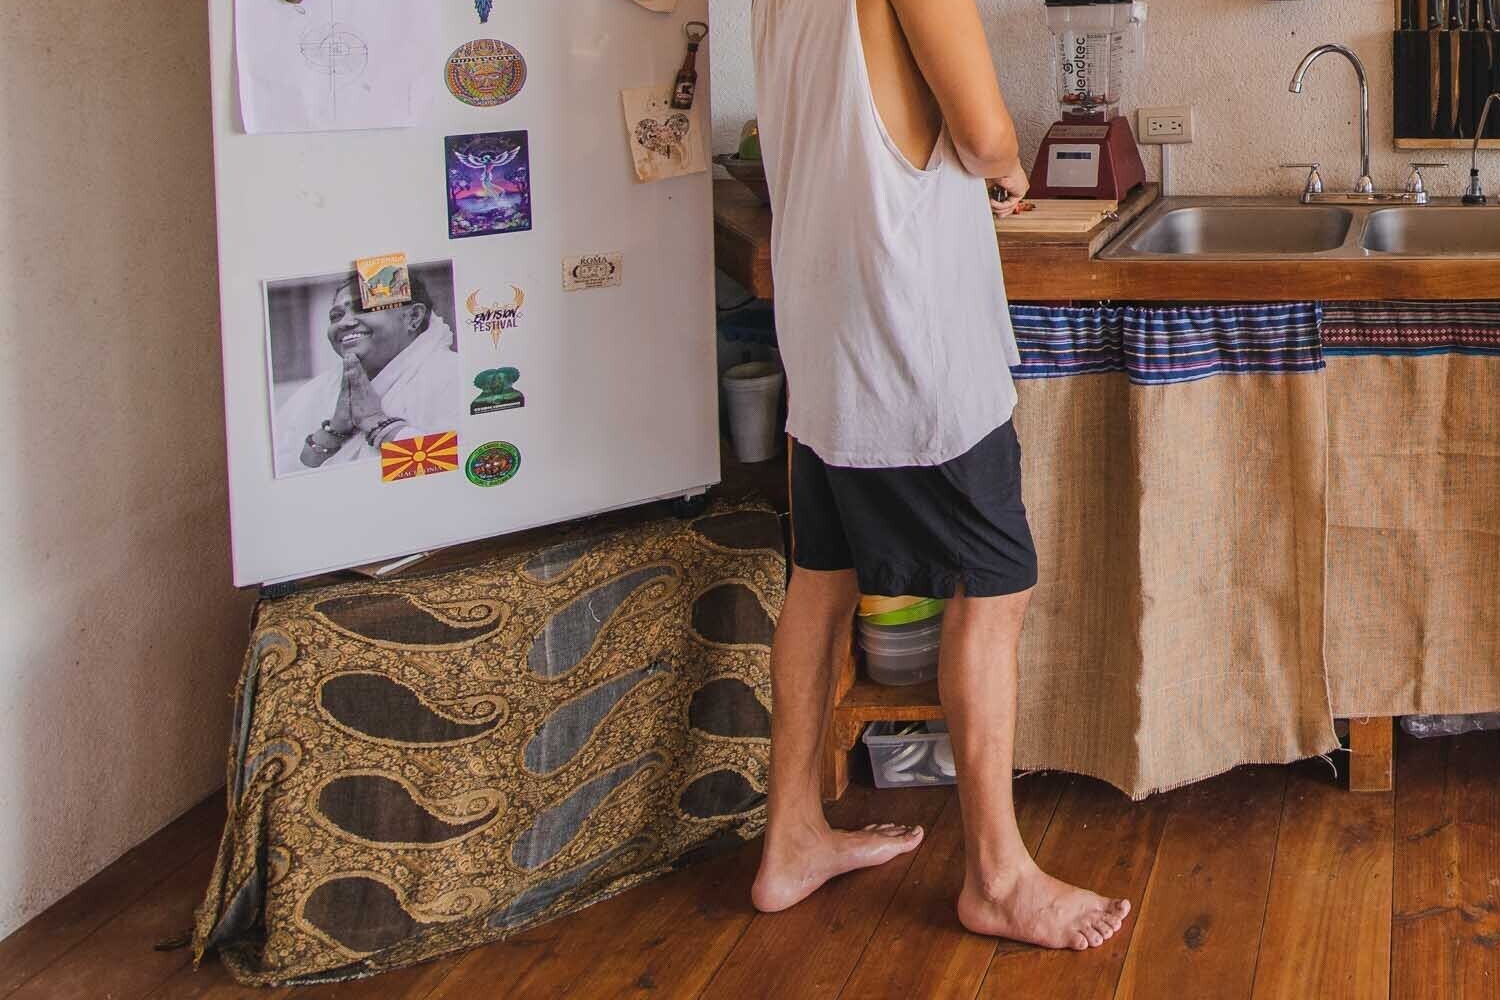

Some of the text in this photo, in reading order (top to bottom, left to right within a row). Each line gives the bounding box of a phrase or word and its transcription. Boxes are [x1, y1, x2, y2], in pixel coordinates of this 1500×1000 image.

[580, 257, 608, 265] ROMA
[472, 307, 518, 323] ENVISION
[474, 319, 519, 333] FESTIVAL
